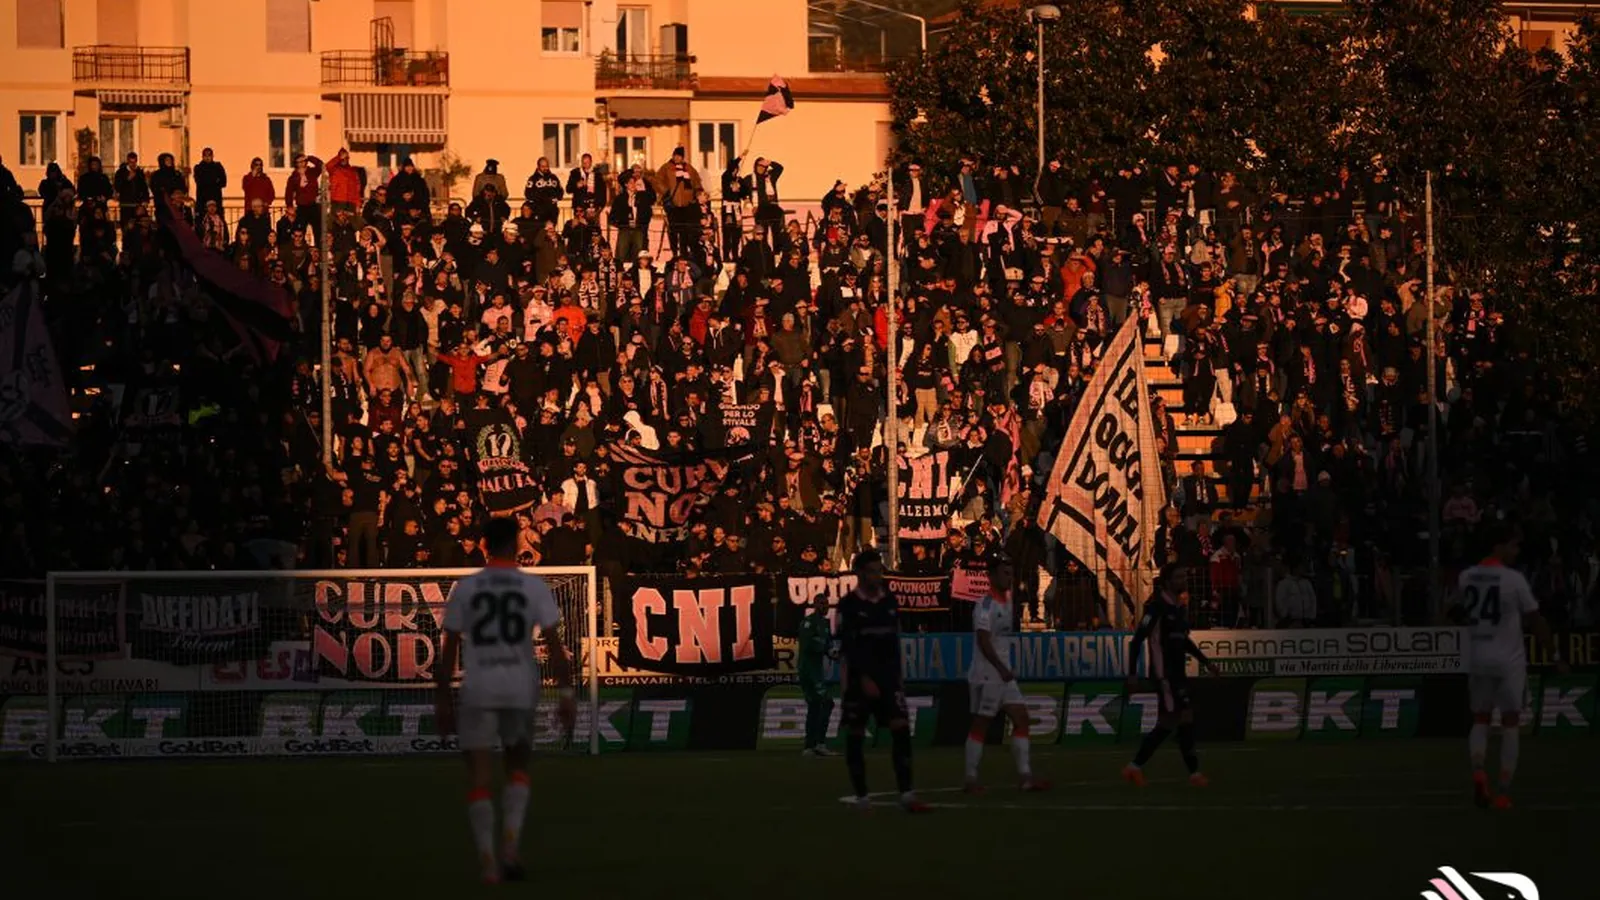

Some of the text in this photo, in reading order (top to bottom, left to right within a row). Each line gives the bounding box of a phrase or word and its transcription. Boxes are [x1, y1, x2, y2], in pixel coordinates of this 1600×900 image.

[623, 458, 729, 494] CURV
[624, 491, 697, 527] NO
[899, 503, 949, 517] ALERMO
[889, 580, 942, 593] OVUNQUE
[909, 595, 940, 607] VADA
[139, 592, 261, 632] DIFFIDATI
[315, 580, 458, 630] CURV
[471, 591, 527, 646] 26
[1465, 584, 1501, 626] 24
[631, 584, 756, 664] CNI
[314, 623, 437, 680] NOR
[1199, 640, 1339, 655] FARMACIA
[1279, 659, 1296, 672] via
[1301, 658, 1339, 672] Martiri
[1342, 658, 1368, 671] della
[1373, 657, 1437, 671] Liberazione
[89, 678, 158, 692] CHIAVARI
[604, 676, 674, 686] CHIAVARI
[757, 674, 800, 685] 3084
[2, 705, 182, 748] BKT
[261, 703, 438, 740] BKT
[763, 696, 933, 738] BT
[1251, 688, 1416, 731] BKT
[410, 738, 460, 752] Gold
